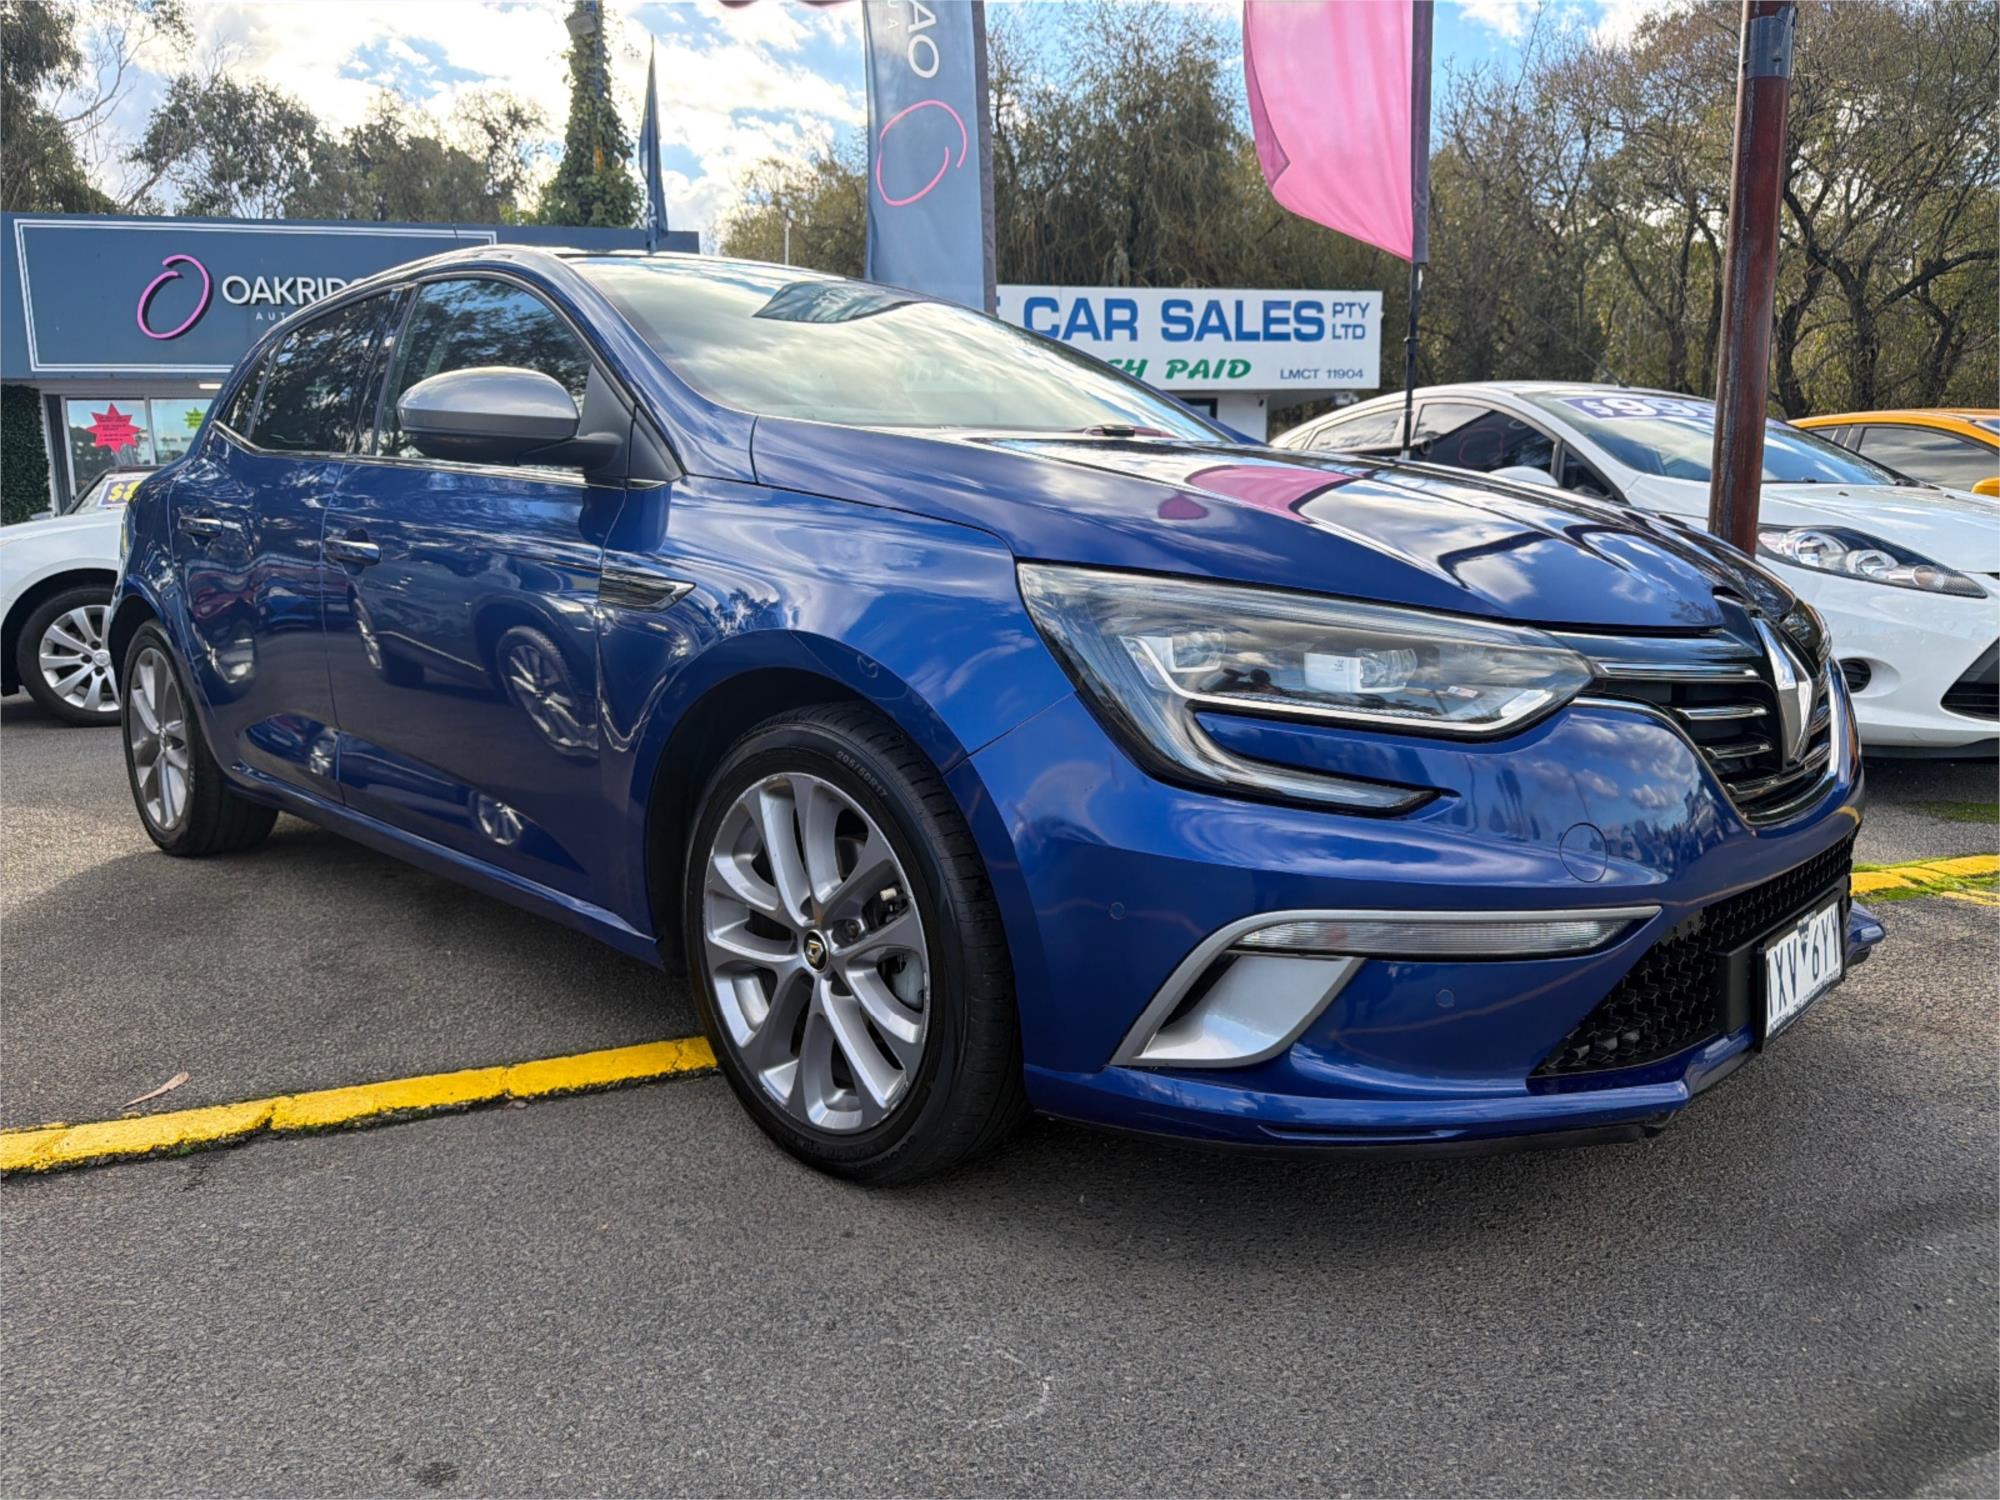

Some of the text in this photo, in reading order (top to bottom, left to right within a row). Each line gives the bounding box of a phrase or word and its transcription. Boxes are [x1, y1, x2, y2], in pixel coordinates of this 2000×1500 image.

[221, 275, 365, 305] OAKRID
[1024, 296, 1138, 342] CAR
[1161, 298, 1325, 342] SALES
[1332, 302, 1370, 319] PTY
[1332, 323, 1366, 340] LTD
[1165, 358, 1252, 380] PAID
[1280, 368, 1365, 380] LMCT 11904
